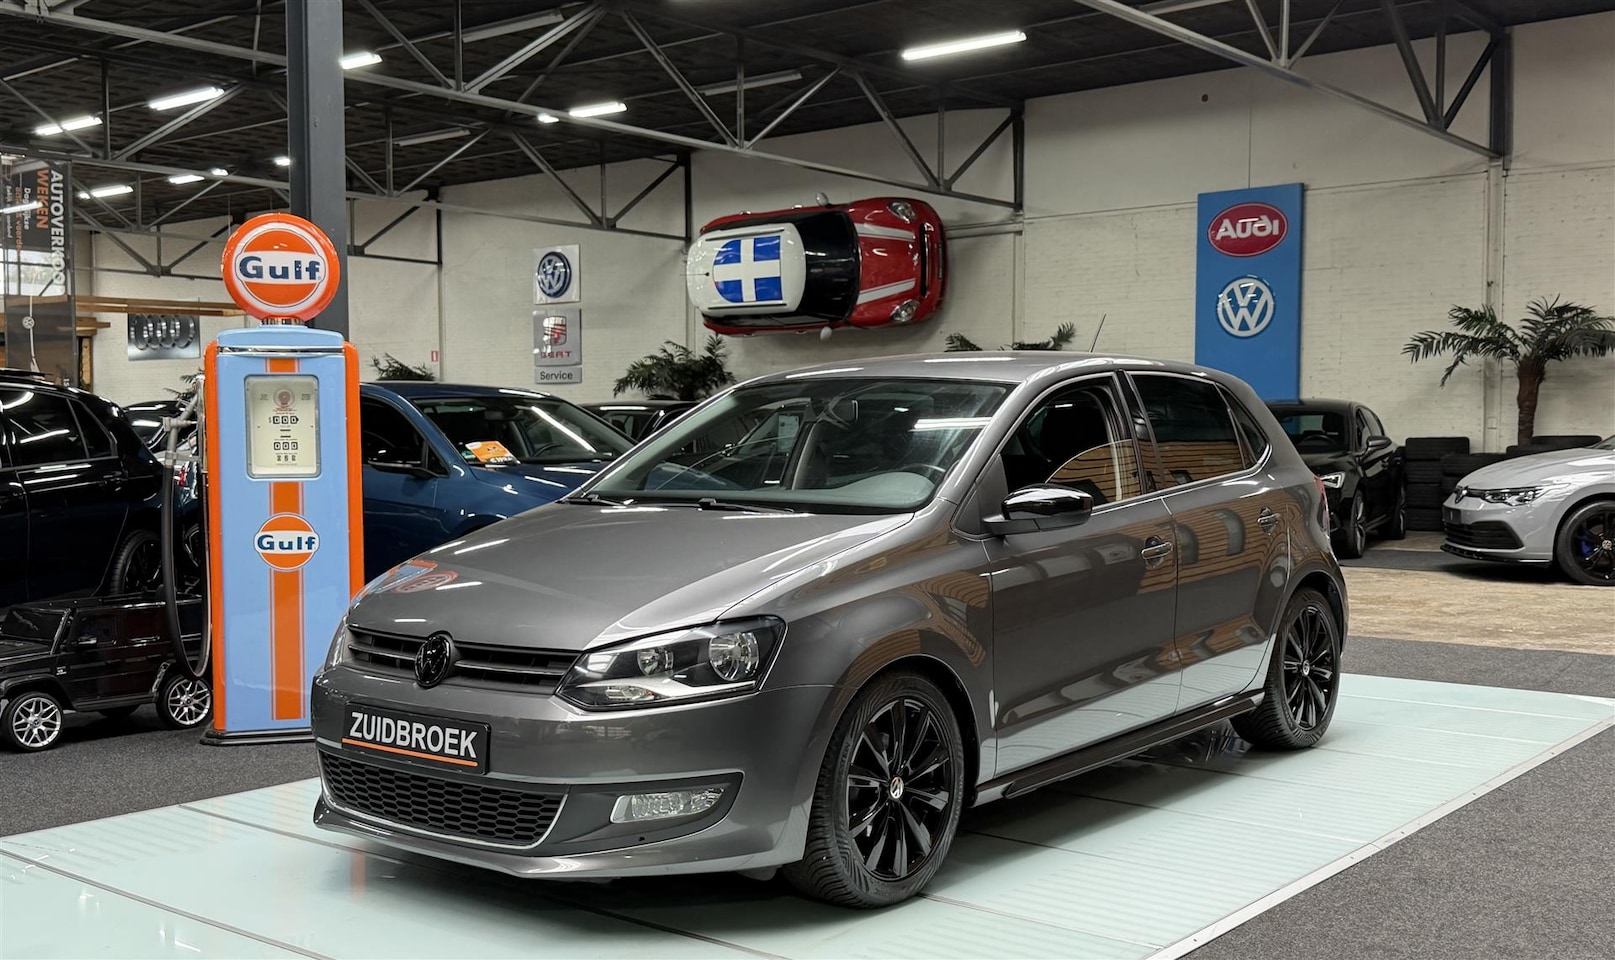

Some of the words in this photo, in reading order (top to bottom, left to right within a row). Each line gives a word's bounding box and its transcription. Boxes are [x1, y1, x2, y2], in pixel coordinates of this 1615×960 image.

[23, 187, 31, 230] Dagijkse
[36, 168, 49, 229] WEKEN
[239, 256, 320, 281] Gulf
[540, 371, 573, 380] Service
[257, 534, 316, 551] Gulf
[349, 711, 478, 759] ZUIDBROEK
